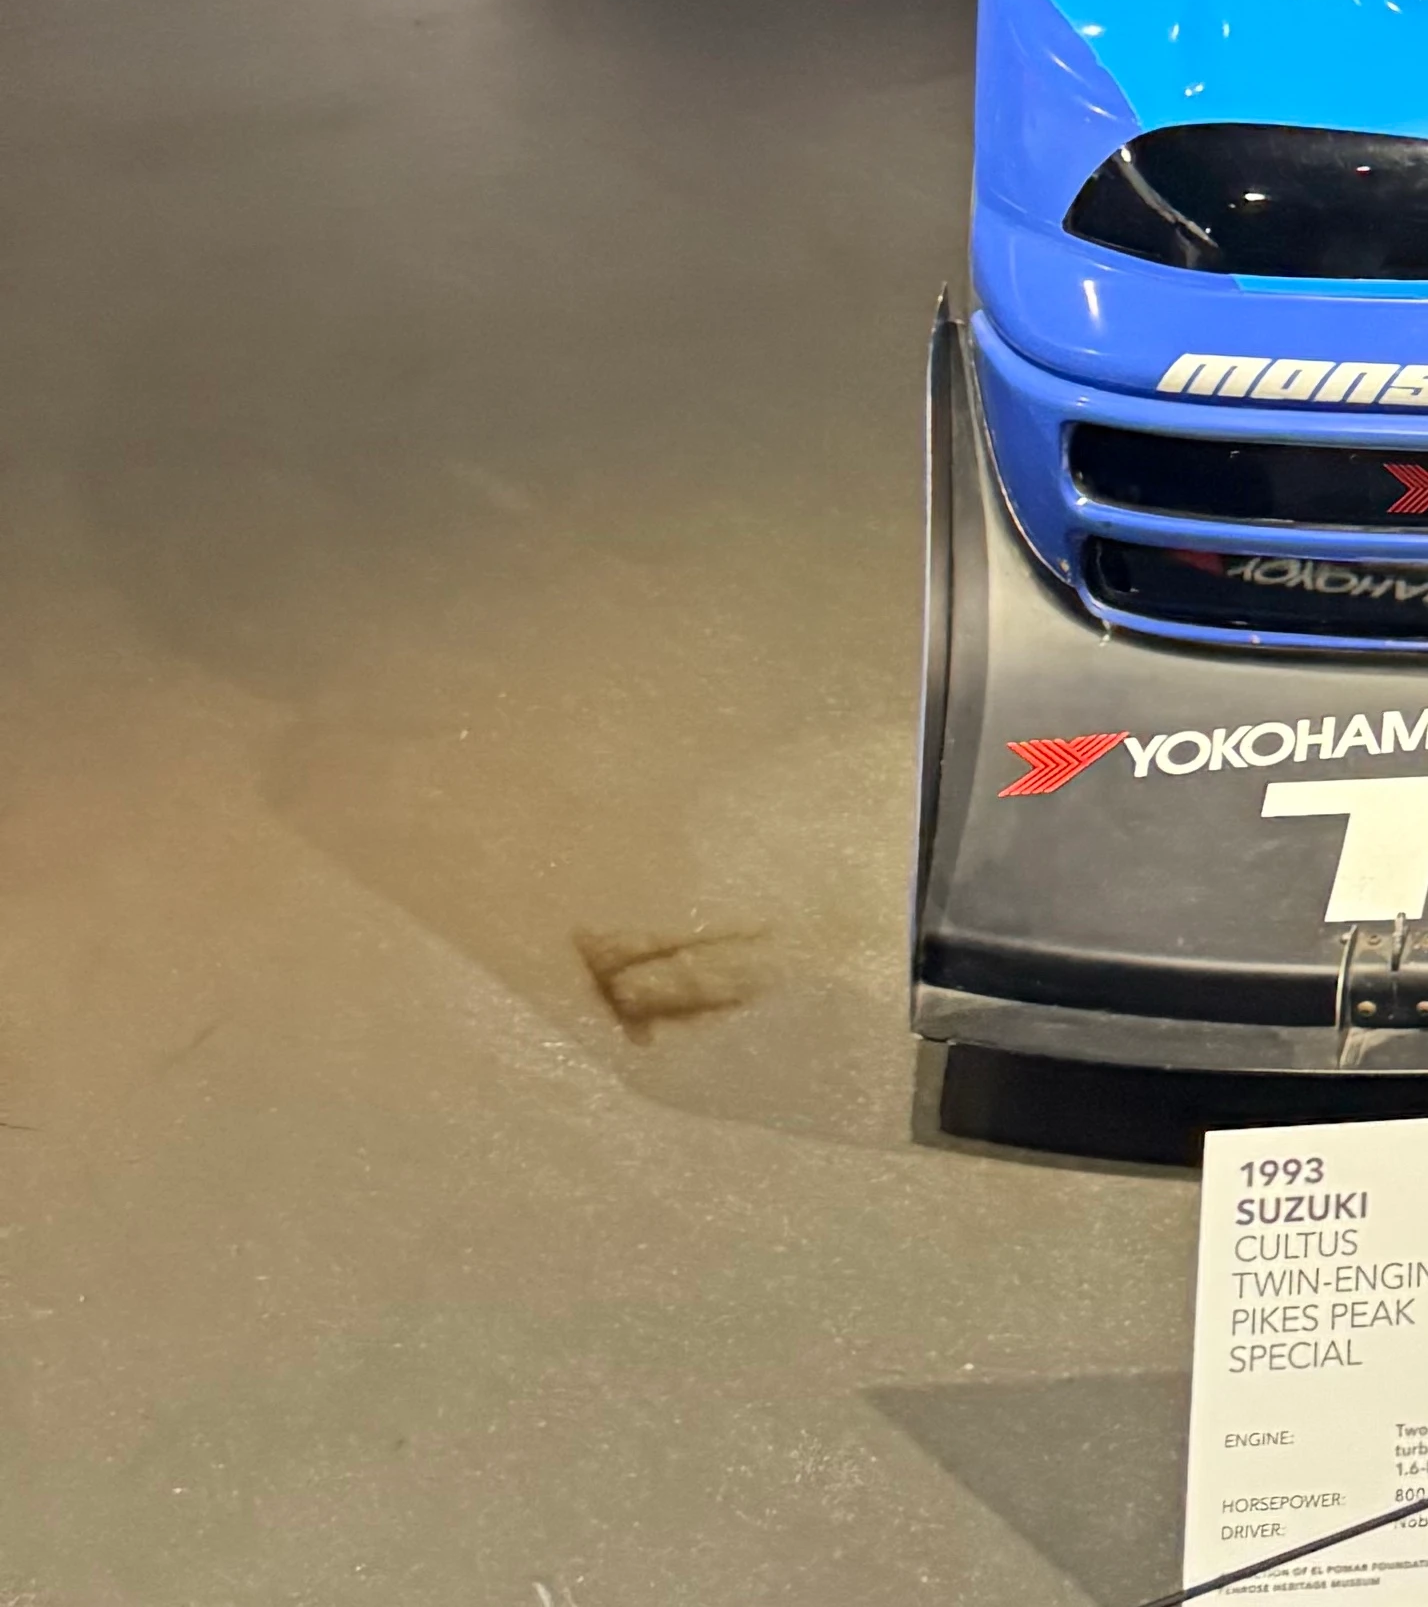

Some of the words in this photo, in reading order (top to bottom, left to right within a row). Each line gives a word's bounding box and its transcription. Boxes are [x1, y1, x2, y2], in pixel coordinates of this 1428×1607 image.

[1240, 1157, 1324, 1188] 1993
[1235, 1191, 1368, 1226] SUZUKI
[1234, 1228, 1358, 1263] CULTUS
[1231, 1303, 1319, 1337] PIKES
[1330, 1298, 1415, 1331] PEAK
[1228, 1338, 1363, 1373] SPECIAL
[1395, 1423, 1428, 1438] Two
